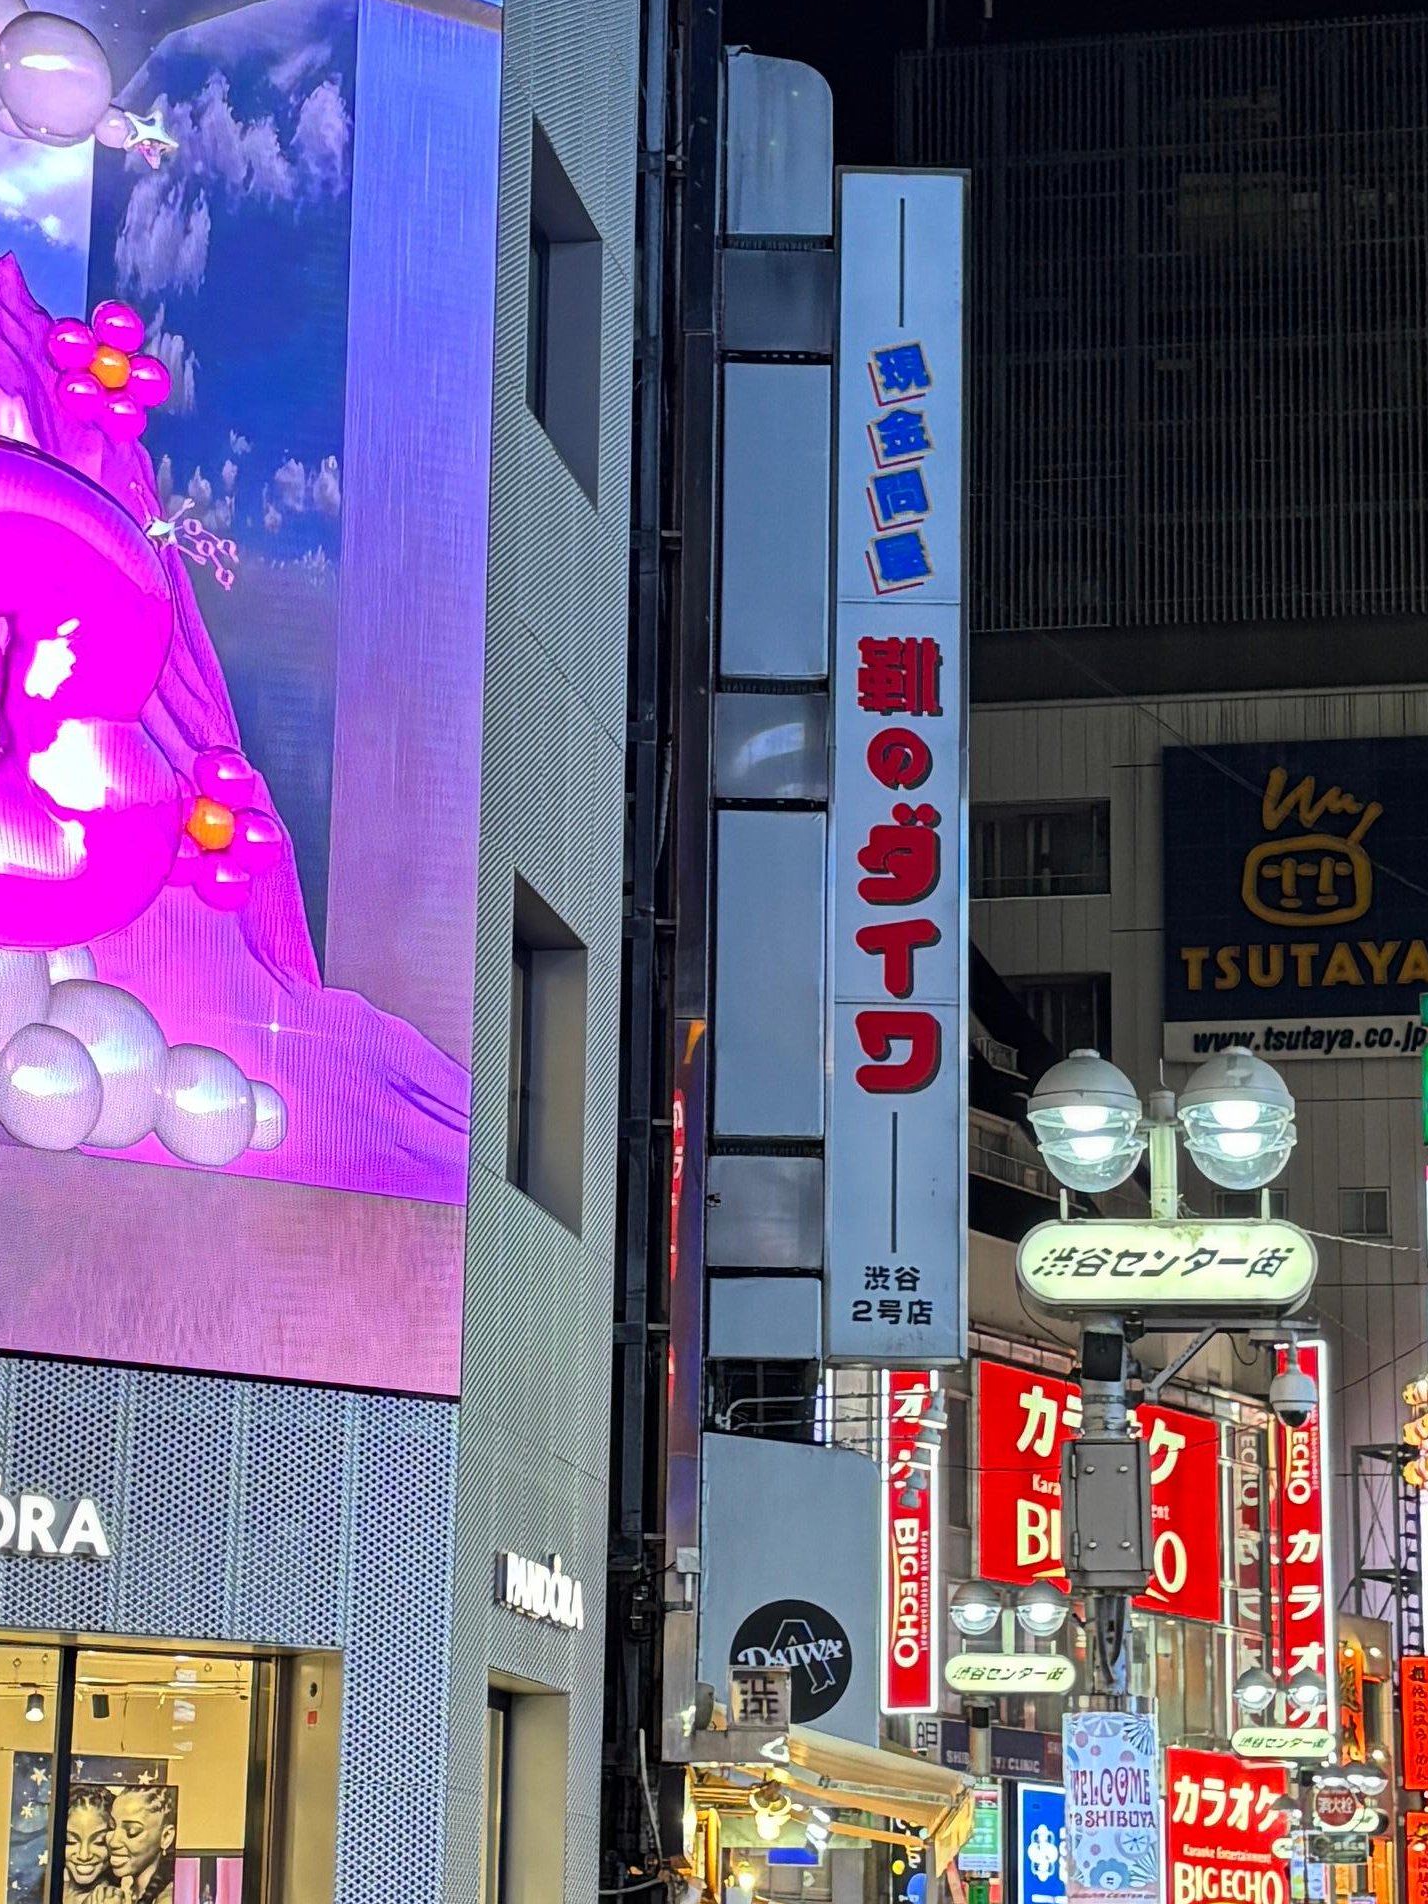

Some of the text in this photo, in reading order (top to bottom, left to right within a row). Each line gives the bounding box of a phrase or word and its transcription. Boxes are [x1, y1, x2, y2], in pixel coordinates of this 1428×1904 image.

[867, 341, 932, 594] 現金問屋
[854, 634, 944, 1096] 靴のダイワ
[1191, 1021, 1427, 1062] www.tsutaya.co.jp
[863, 1263, 921, 1293] 渋谷
[1031, 1245, 1297, 1279] 渋谷センター街
[851, 1298, 933, 1327] 2号店
[1287, 1430, 1313, 1506] ECHO
[1017, 1498, 1062, 1567] BI
[505, 1553, 585, 1631] PANDORA
[893, 1518, 919, 1669] BIG ECHO
[952, 1666, 1067, 1682] 渋谷センター街
[1071, 1766, 1150, 1807] WELCOME
[1172, 1775, 1283, 1833] カラオケ
[1084, 1809, 1156, 1829] SHIBUYA
